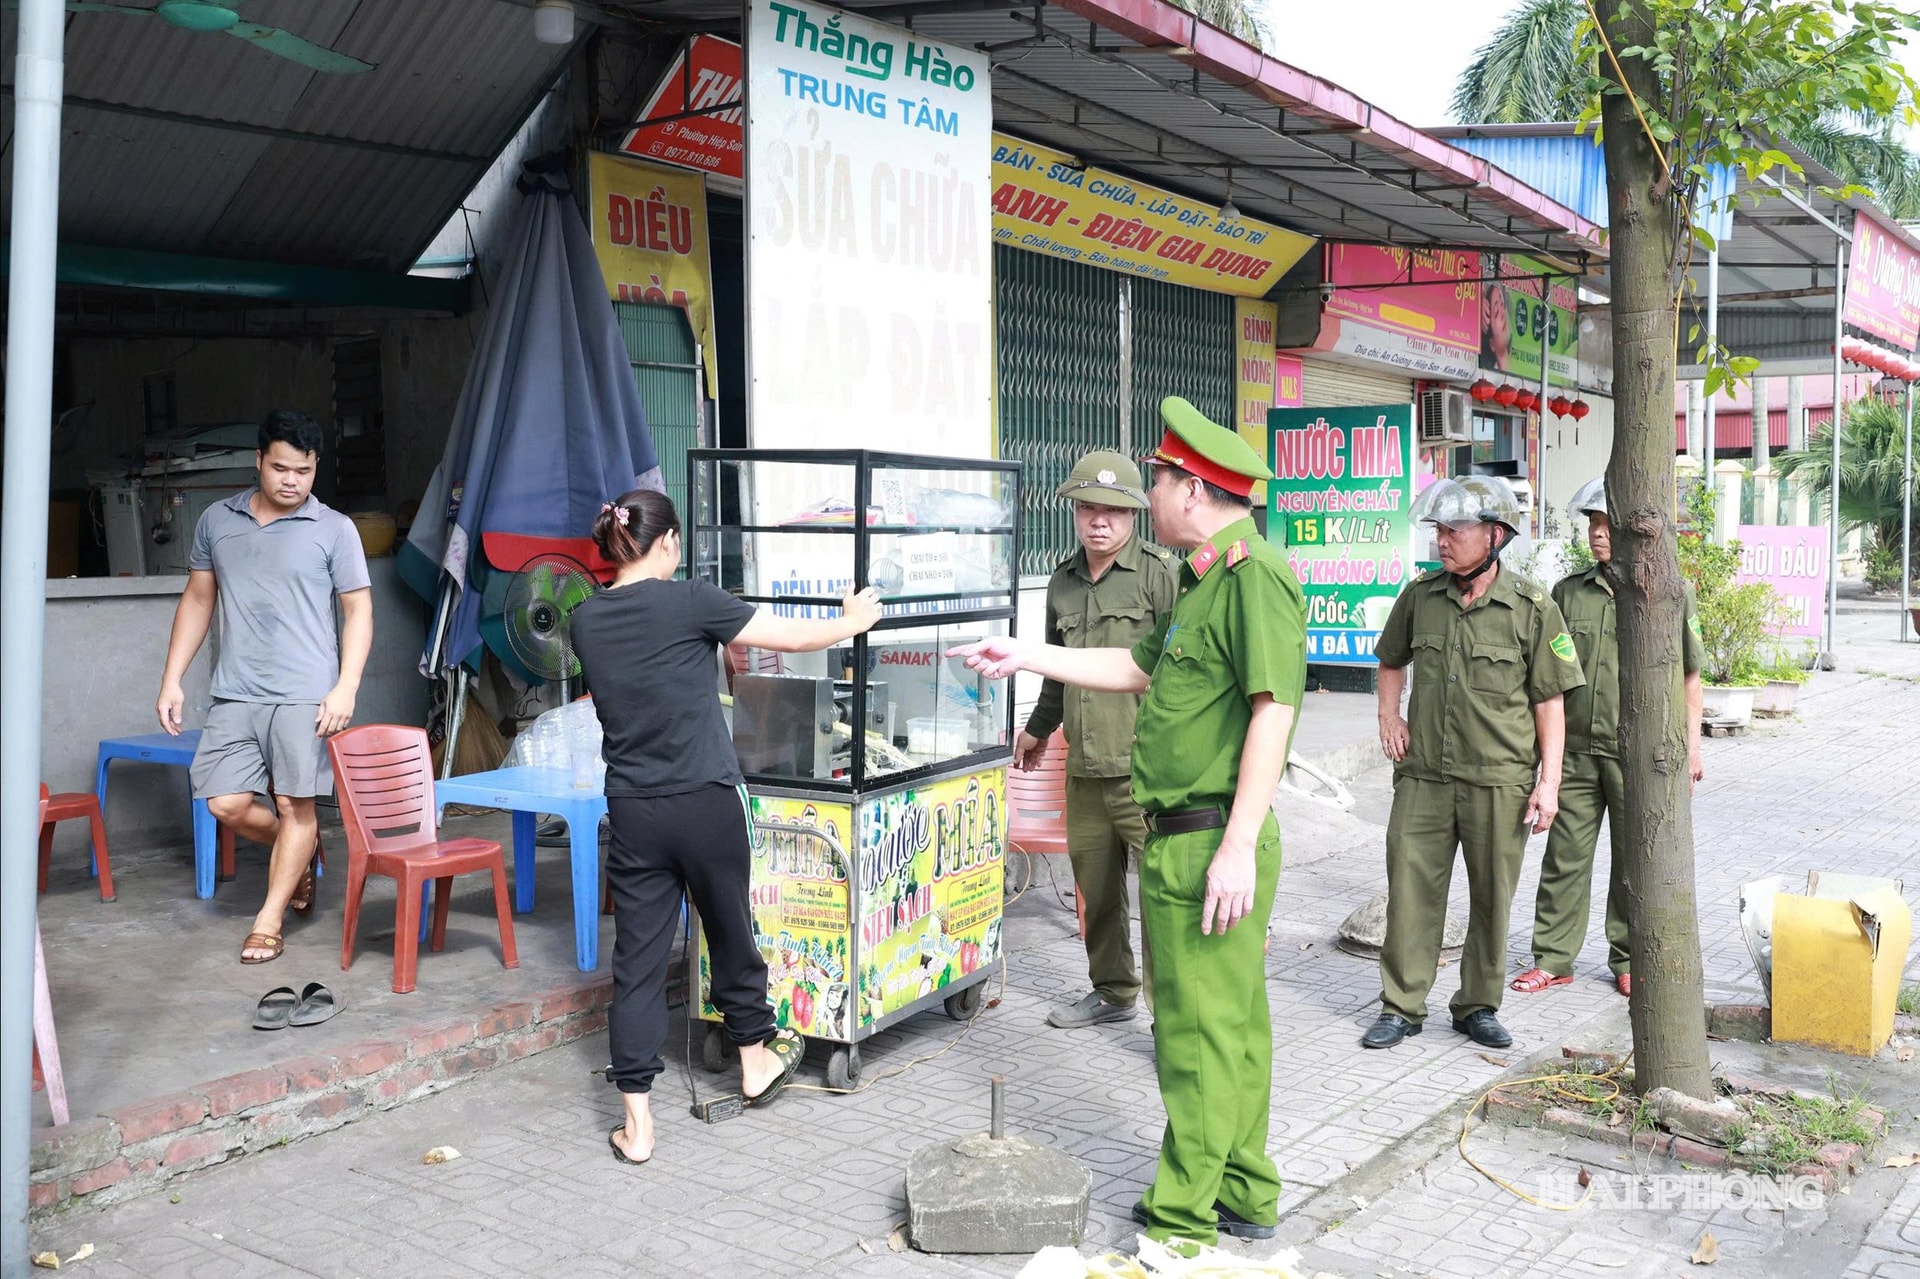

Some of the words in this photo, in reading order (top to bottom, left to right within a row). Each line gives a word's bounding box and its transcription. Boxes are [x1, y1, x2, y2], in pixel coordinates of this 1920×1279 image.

[769, 2, 892, 80] Thắng
[905, 42, 975, 91] Hào
[681, 67, 742, 126] THA
[777, 68, 886, 119] TRUNG
[898, 95, 959, 136] TÂM
[664, 146, 721, 167] 0977.810.686
[677, 127, 708, 145] Phường
[707, 134, 727, 149] Hiệp
[992, 146, 1036, 171] BÁN
[1088, 179, 1137, 206] CHỮA
[1146, 197, 1178, 217] LẮP
[1176, 211, 1209, 228] ĐẶT
[1213, 220, 1246, 239] BẢO
[1245, 231, 1270, 245] TRÌ
[608, 185, 693, 255] ĐIỀU
[992, 183, 1069, 227] ẠNH
[1081, 212, 1163, 252] ĐIỆN
[1156, 235, 1207, 265] GIA
[1200, 247, 1273, 281] DỤNG
[1021, 234, 1050, 250] Chất
[1049, 240, 1081, 259] lượng
[1110, 257, 1135, 270] hành
[1243, 314, 1272, 344] BÌNH
[1242, 355, 1272, 385] NÓNG
[1281, 375, 1298, 400] NAILS
[1275, 417, 1345, 479] NƯỚC
[1352, 416, 1402, 479] MÍA
[1276, 485, 1353, 512] NGUYÊN
[1351, 480, 1402, 511] CHẤT
[1293, 518, 1317, 542] 15
[1325, 515, 1391, 544] K/Lít
[1289, 548, 1309, 585] ỐC
[1312, 546, 1375, 584] KHỔNG
[1377, 547, 1402, 584] LỒ
[1779, 536, 1821, 578] ĐẦU
[1304, 591, 1348, 624] /Cốc
[1322, 632, 1349, 655] ĐÁ
[932, 776, 1003, 883] MÍA
[752, 885, 778, 911] ẠCH
[863, 900, 896, 953] SIÊU
[897, 884, 931, 934] SẠCH
